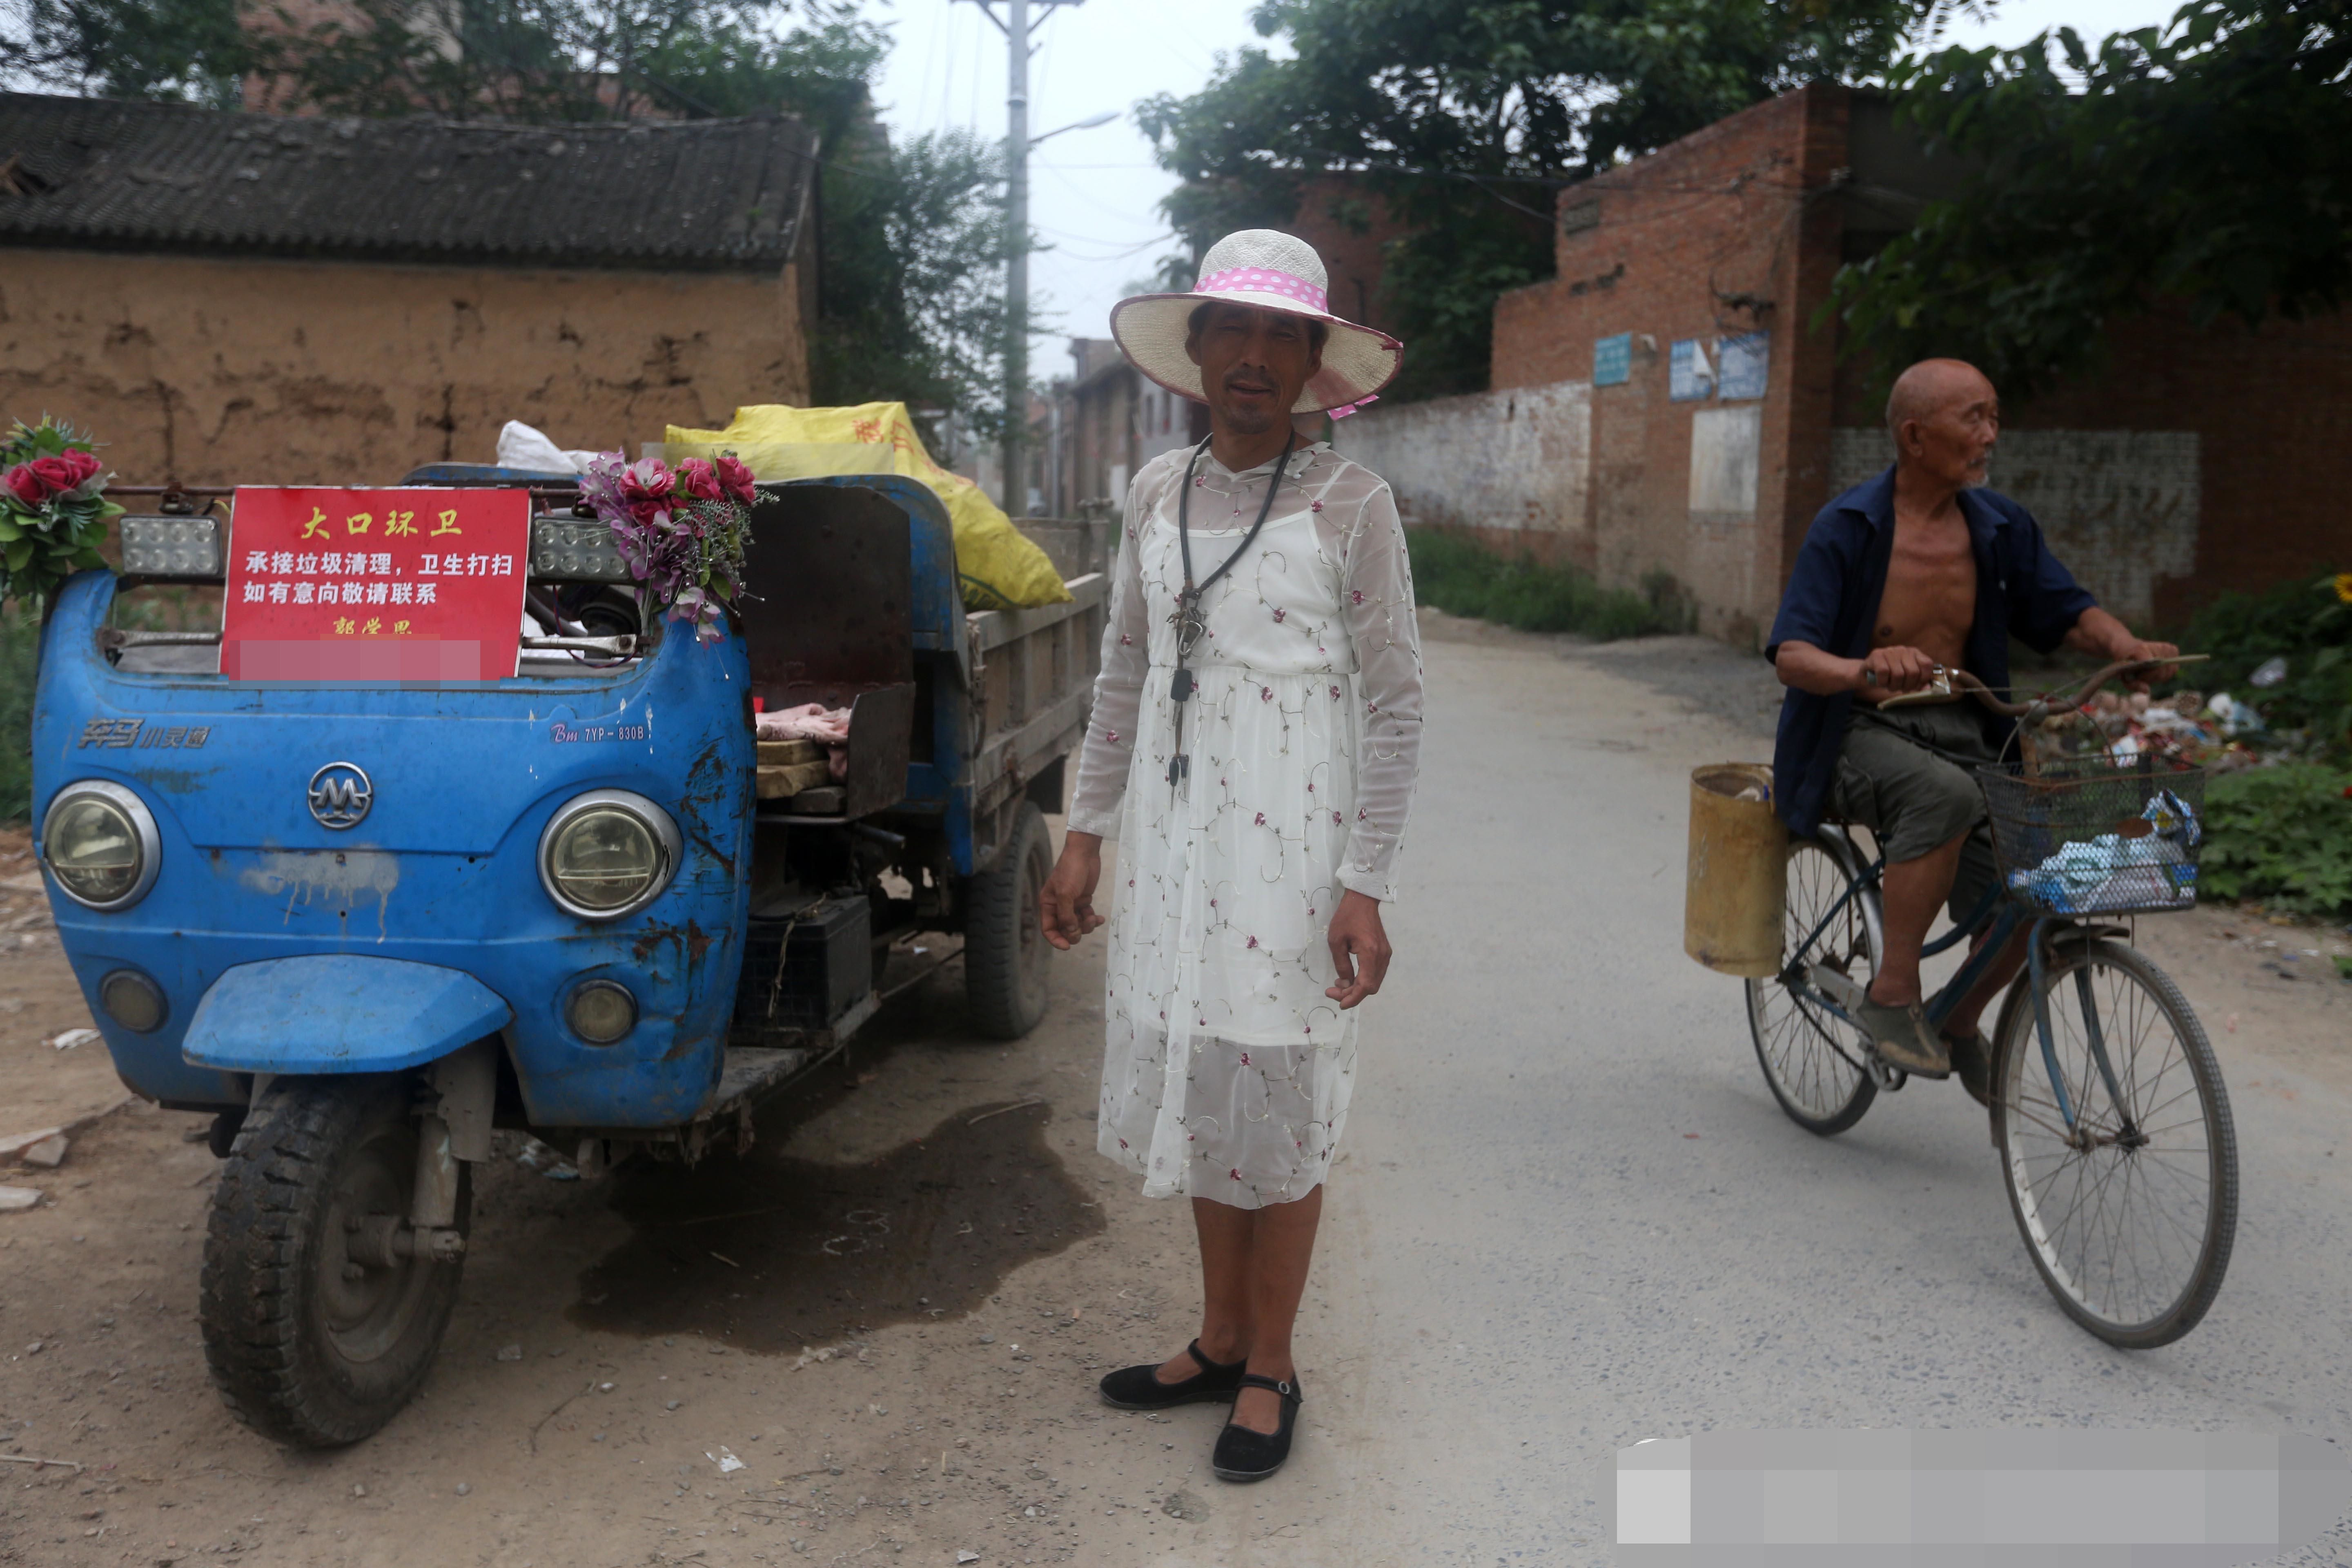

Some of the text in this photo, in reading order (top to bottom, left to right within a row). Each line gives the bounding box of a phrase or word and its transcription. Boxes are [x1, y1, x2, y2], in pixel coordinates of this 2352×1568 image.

[301, 506, 462, 540] 大口环卫
[245, 550, 512, 576] 承接垃圾清理，卫生打扫
[243, 580, 437, 605] 如有意向敬请联系
[78, 718, 211, 748] 奔马小灵通
[585, 726, 644, 742] 7YP-830B
